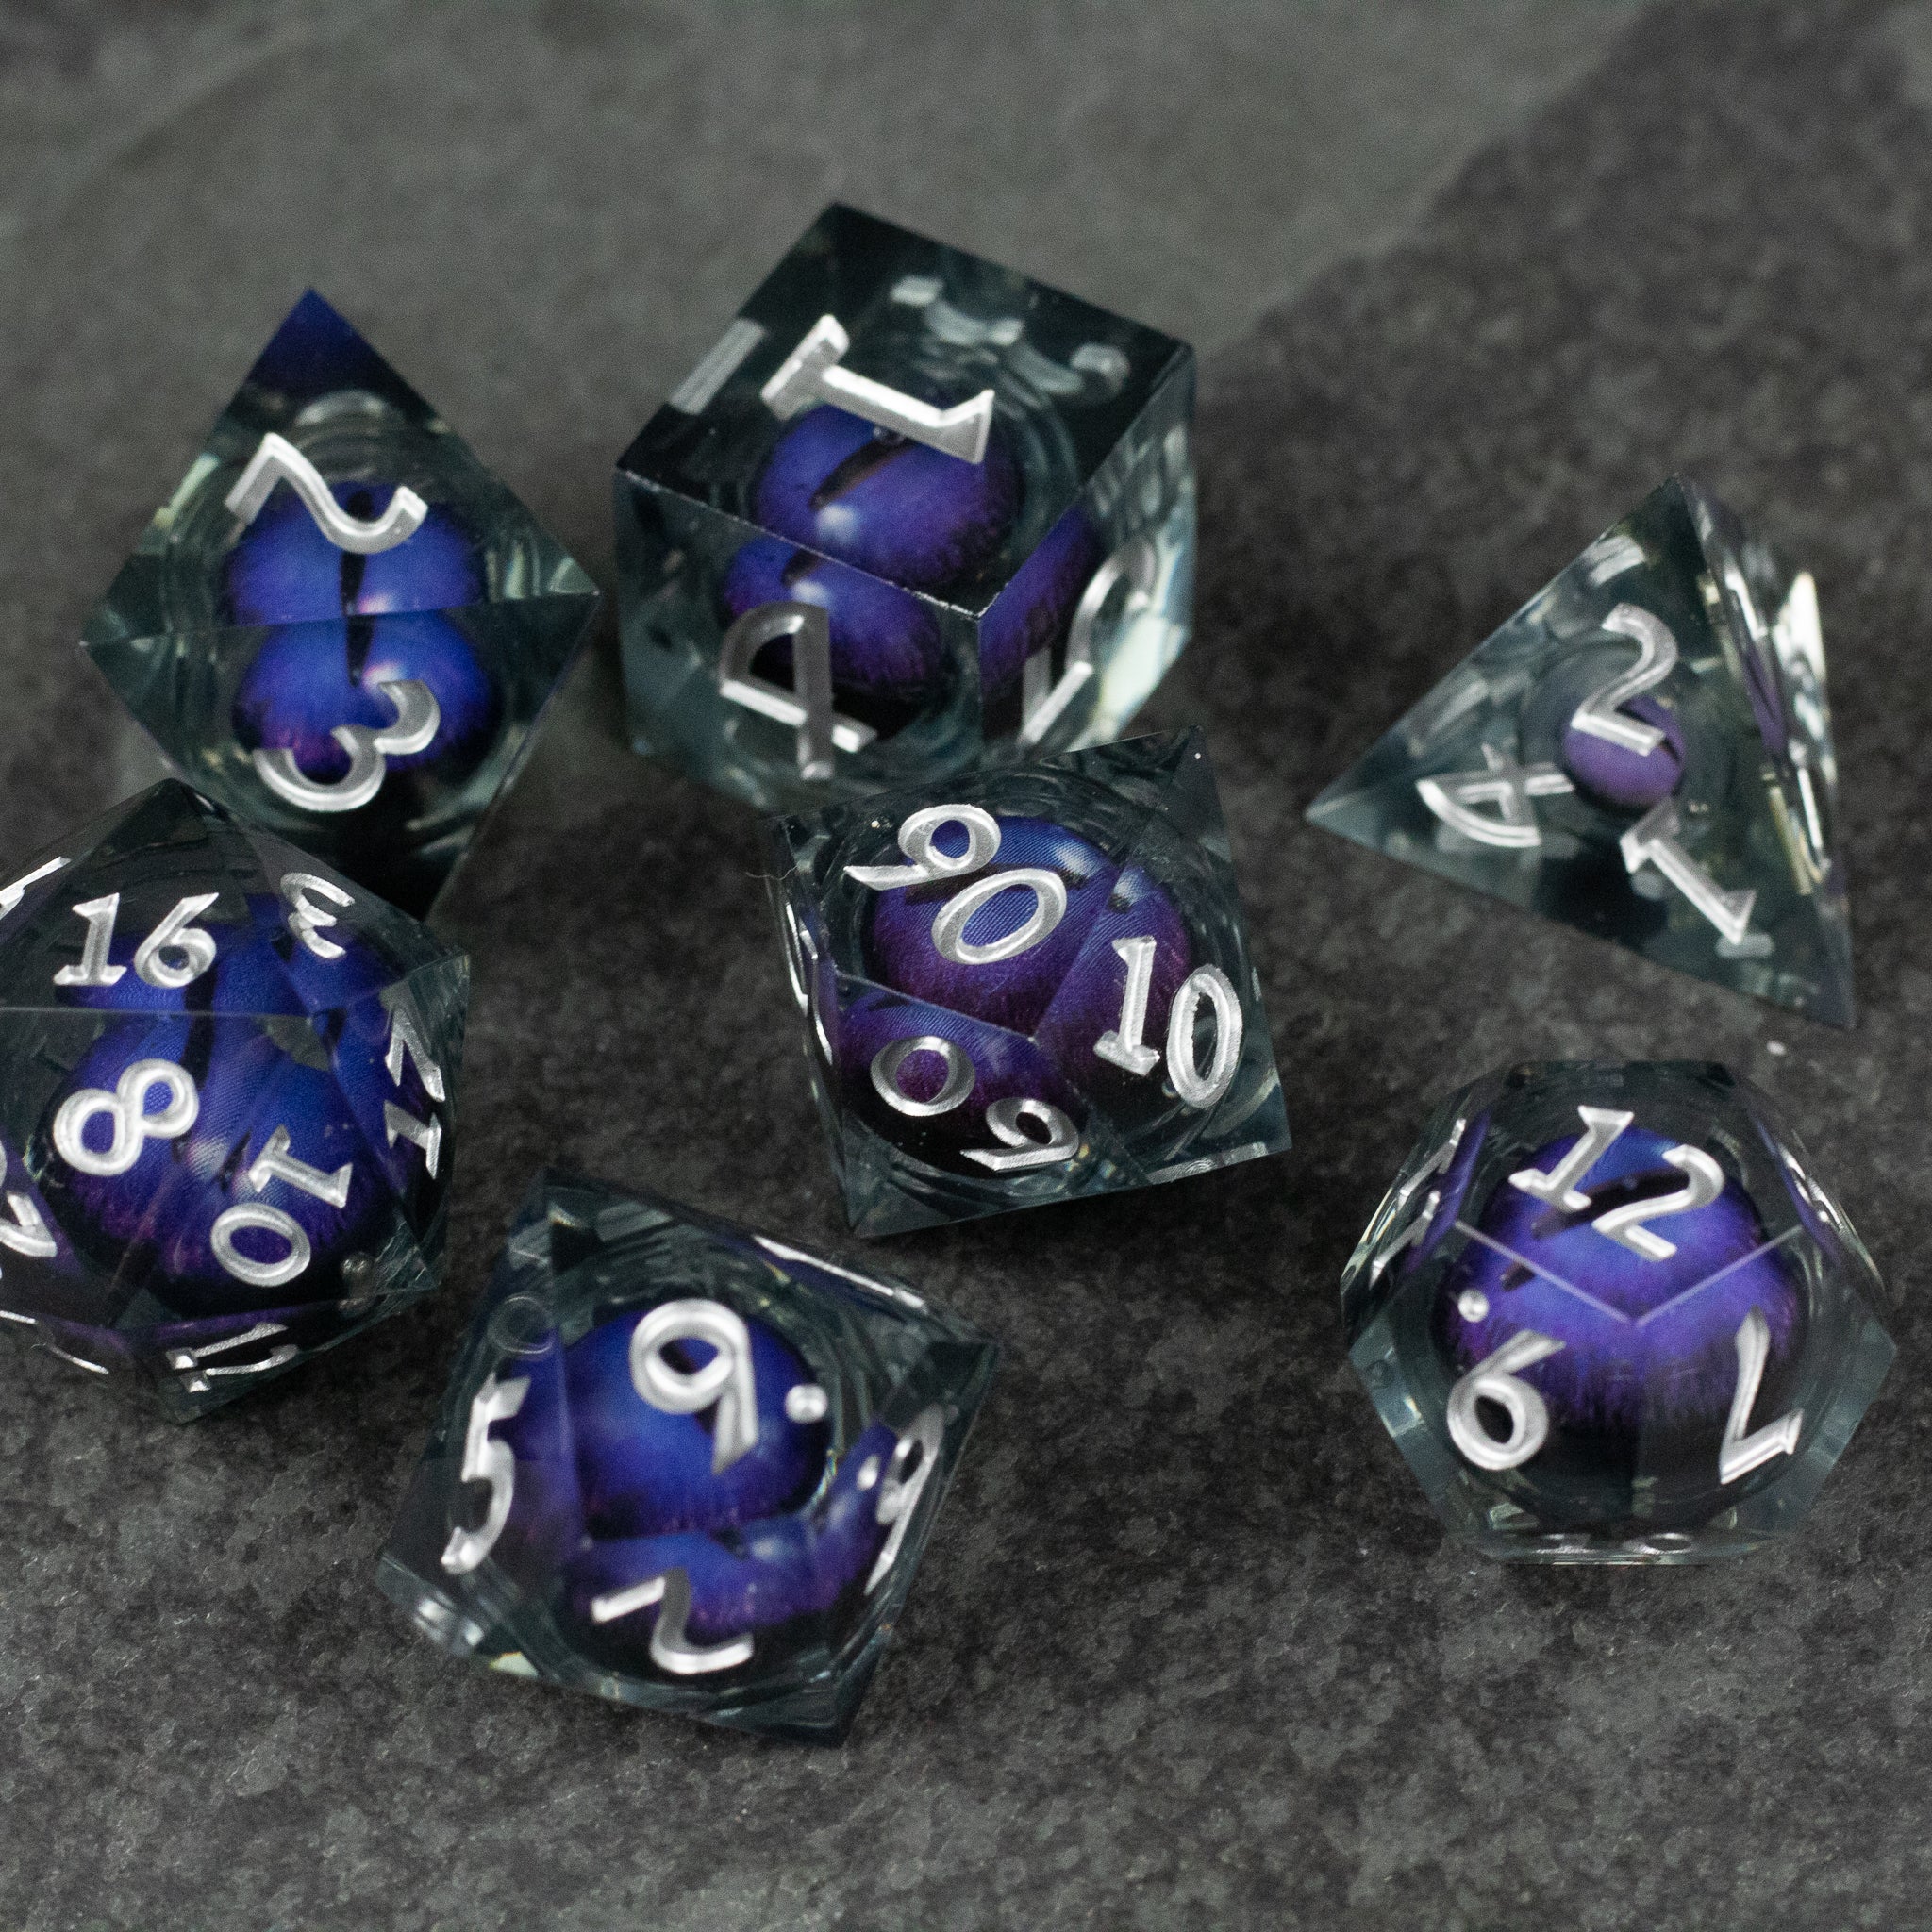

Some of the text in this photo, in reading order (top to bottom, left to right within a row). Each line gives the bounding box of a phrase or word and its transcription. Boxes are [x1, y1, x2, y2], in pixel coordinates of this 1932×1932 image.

[760, 313, 996, 465] 1
[251, 678, 441, 813] 3
[720, 601, 878, 781] 4
[1571, 601, 1679, 758] 2
[54, 891, 221, 989] 16
[843, 802, 1068, 966] 90
[1619, 797, 1757, 946] 1
[1092, 934, 1243, 1110] 10
[53, 1058, 200, 1177] 8
[1507, 1104, 1725, 1262] 12
[209, 1124, 354, 1288] 10
[440, 1373, 533, 1575] 5
